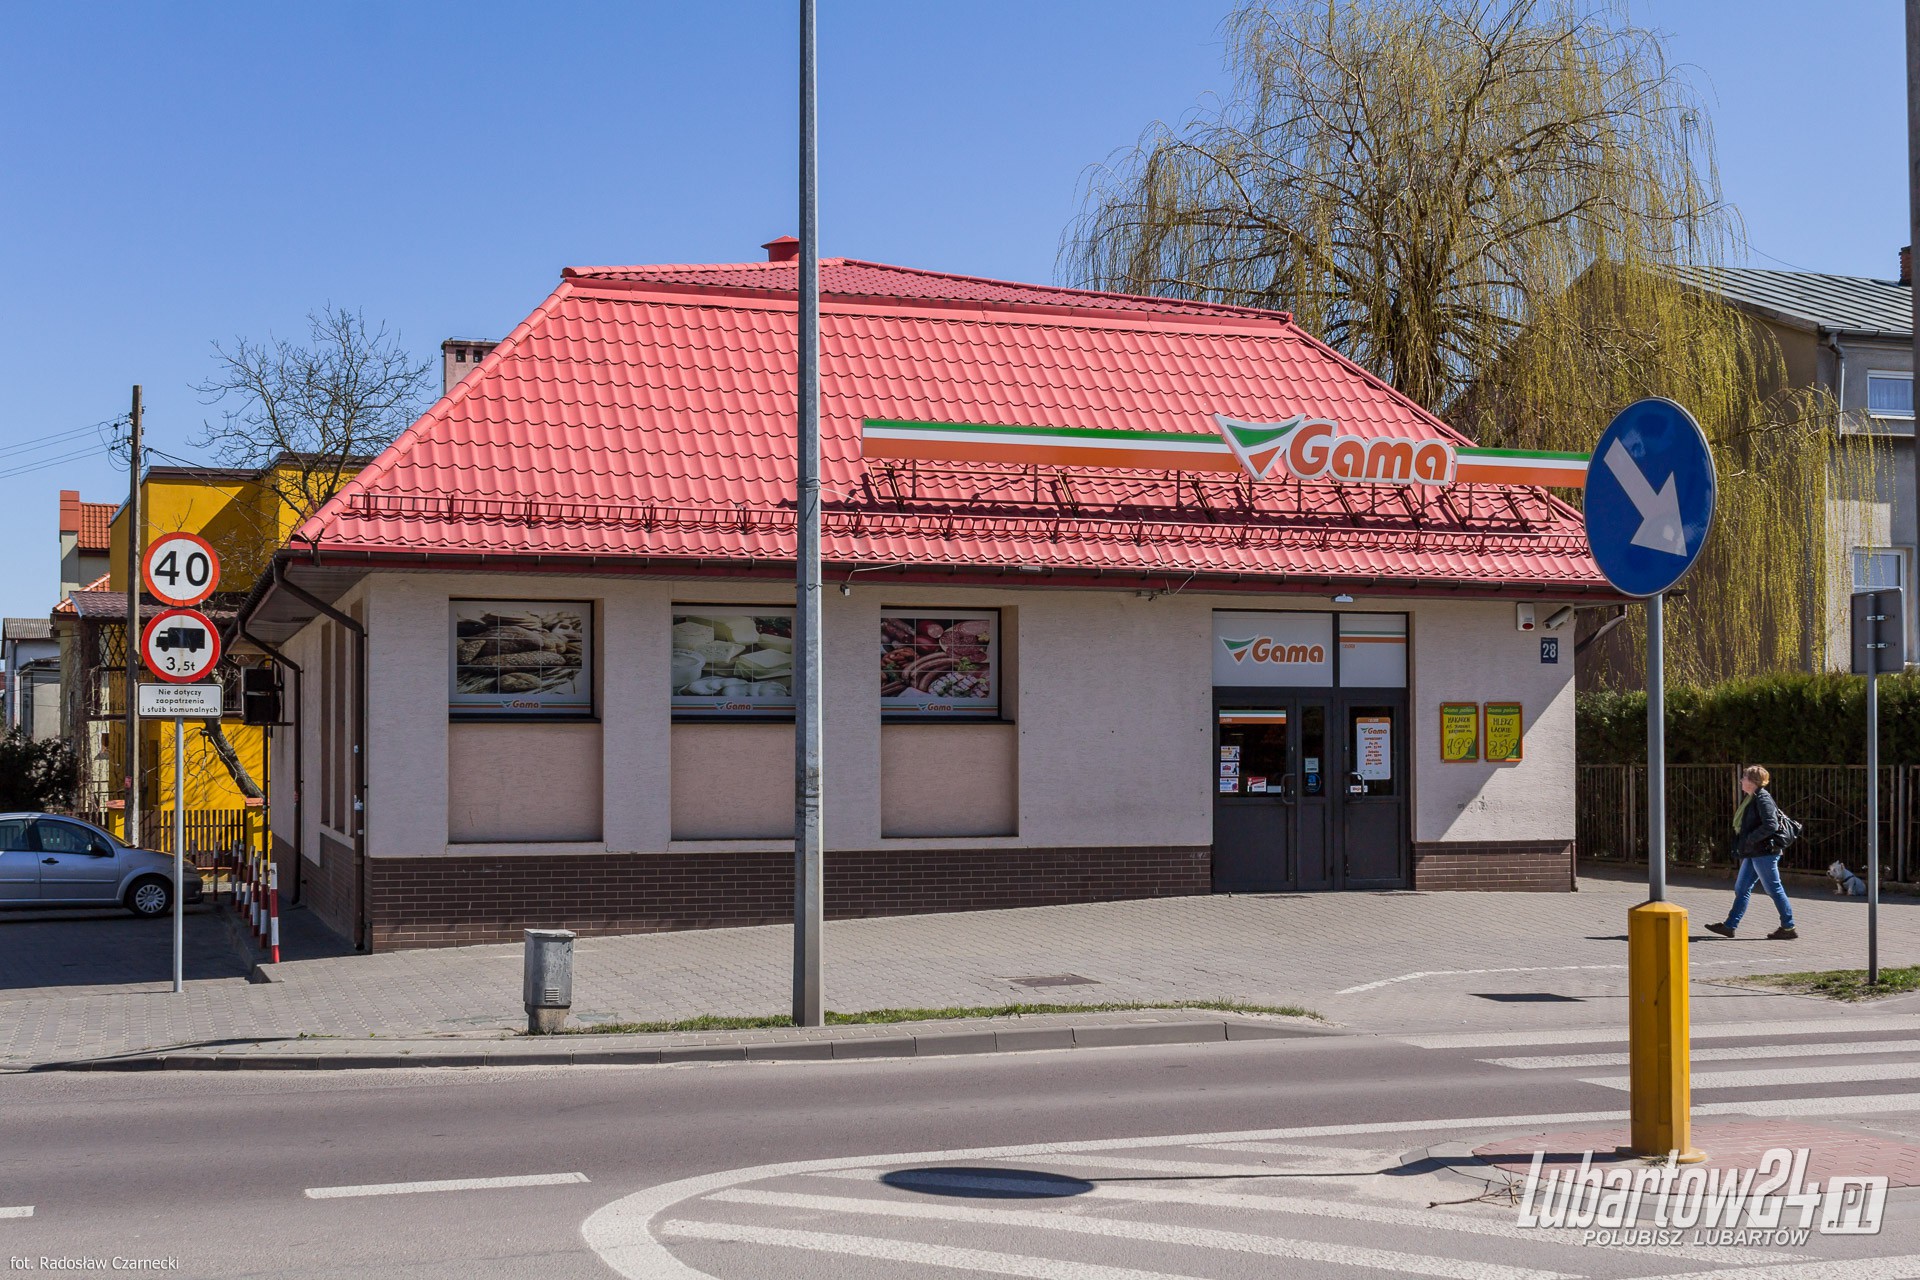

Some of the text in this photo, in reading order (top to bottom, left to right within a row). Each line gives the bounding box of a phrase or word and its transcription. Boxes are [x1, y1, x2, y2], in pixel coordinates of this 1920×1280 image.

[1289, 423, 1448, 482] Gama
[154, 550, 210, 587] 40
[1252, 638, 1324, 662] Gama
[1542, 643, 1556, 658] 28
[166, 657, 196, 672] 3,5t
[174, 689, 202, 697] dotyczy
[156, 697, 205, 705] zaopatrzenia
[512, 700, 539, 708] Gama
[169, 706, 218, 714] komunalnych
[726, 702, 751, 710] Gama
[927, 703, 952, 711] Gama
